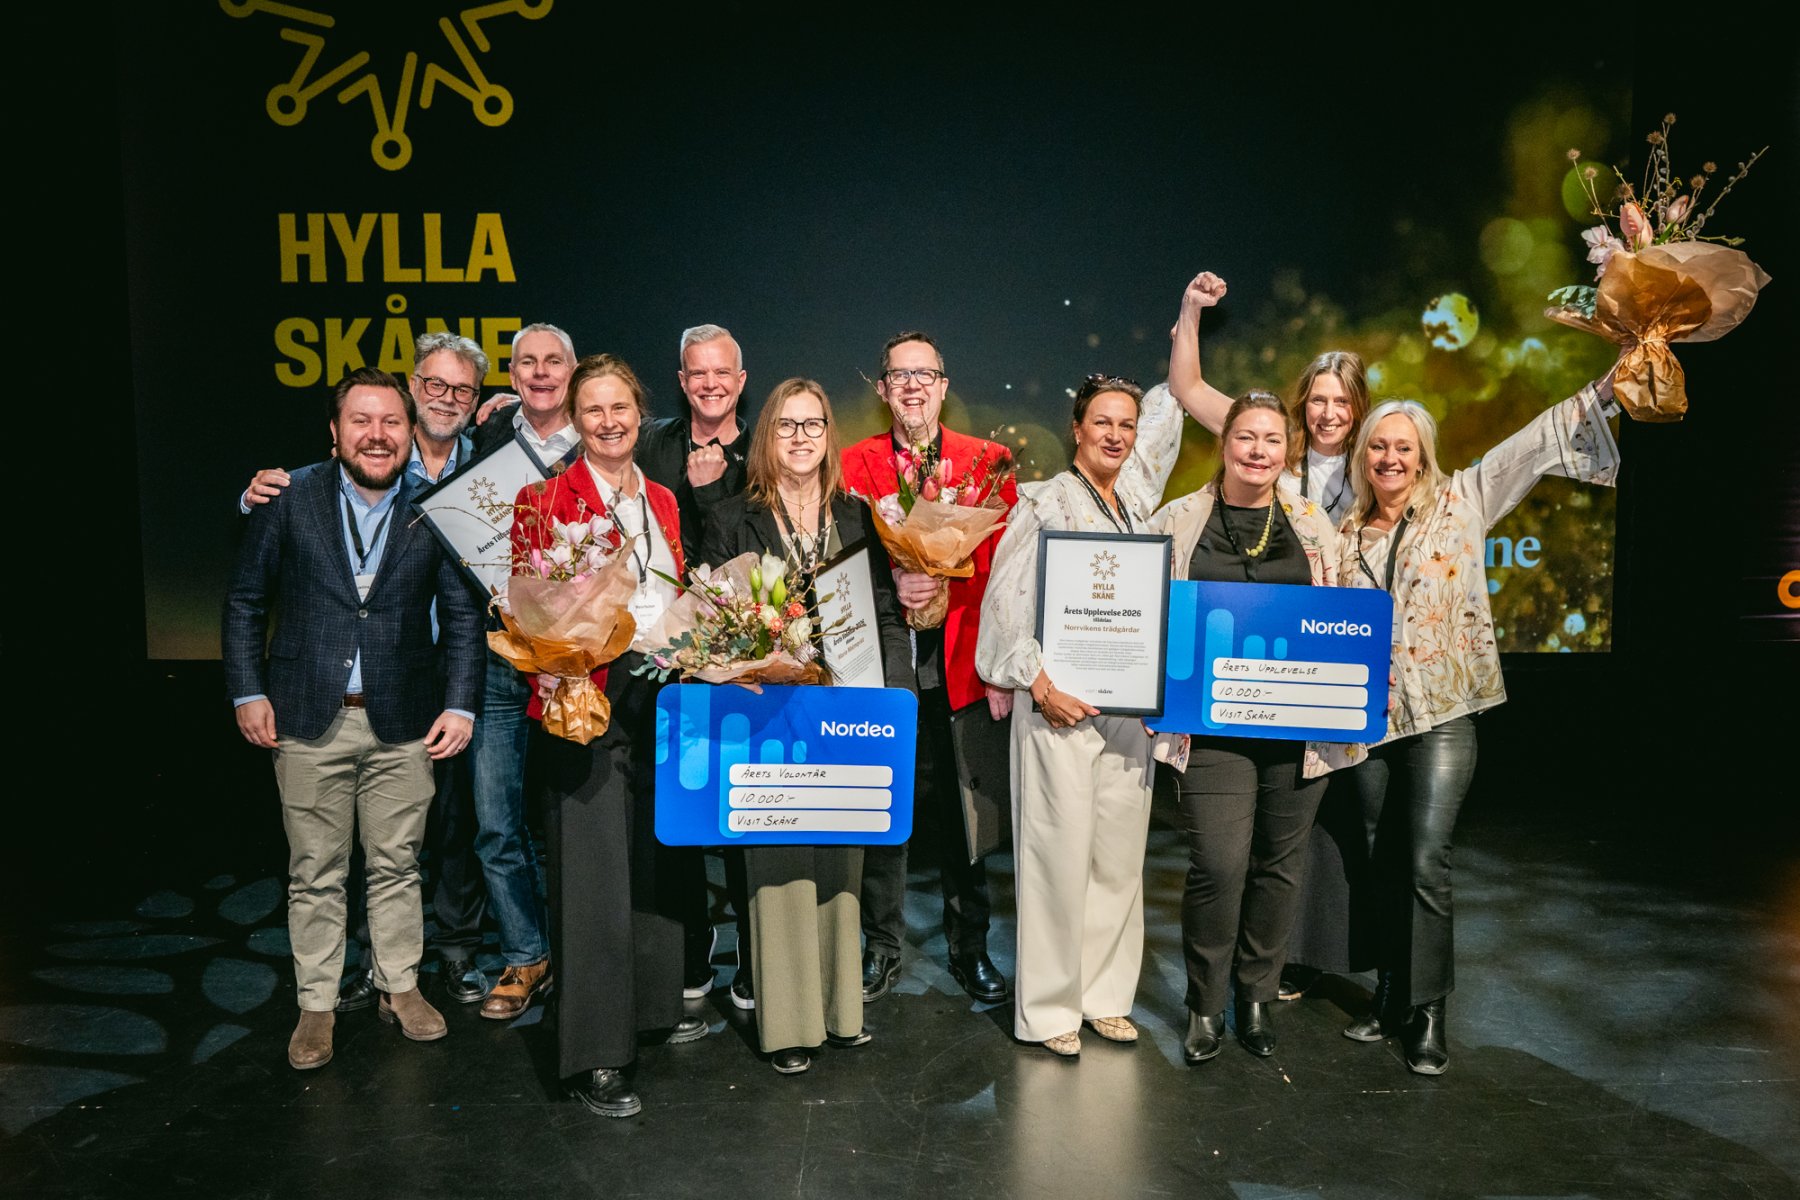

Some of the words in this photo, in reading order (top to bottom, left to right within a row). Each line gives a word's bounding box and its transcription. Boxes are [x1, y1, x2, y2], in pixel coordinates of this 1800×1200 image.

[278, 212, 517, 282] HYLLA
[477, 541, 495, 554] Årets
[1092, 583, 1115, 591] HYLLA
[1091, 591, 1115, 600] SKÅNE
[1064, 605, 1083, 615] Årets
[1083, 608, 1121, 617] Upplevelse
[1122, 609, 1142, 617] 2026
[1064, 624, 1102, 632] Norrvikens
[1102, 626, 1140, 634] trädgårdar
[1301, 618, 1372, 637] Nordea
[1221, 659, 1250, 672] ÅRETS
[1258, 664, 1319, 675] UPPLEVELSE
[1219, 709, 1243, 719] VISIT
[1244, 709, 1277, 721] SKÅNE
[820, 720, 895, 738] Nordea
[741, 766, 772, 779] ÅRETS
[779, 768, 827, 779] VOLONTÄR
[737, 815, 761, 826] VISIT
[763, 814, 799, 827] SKÅNE
